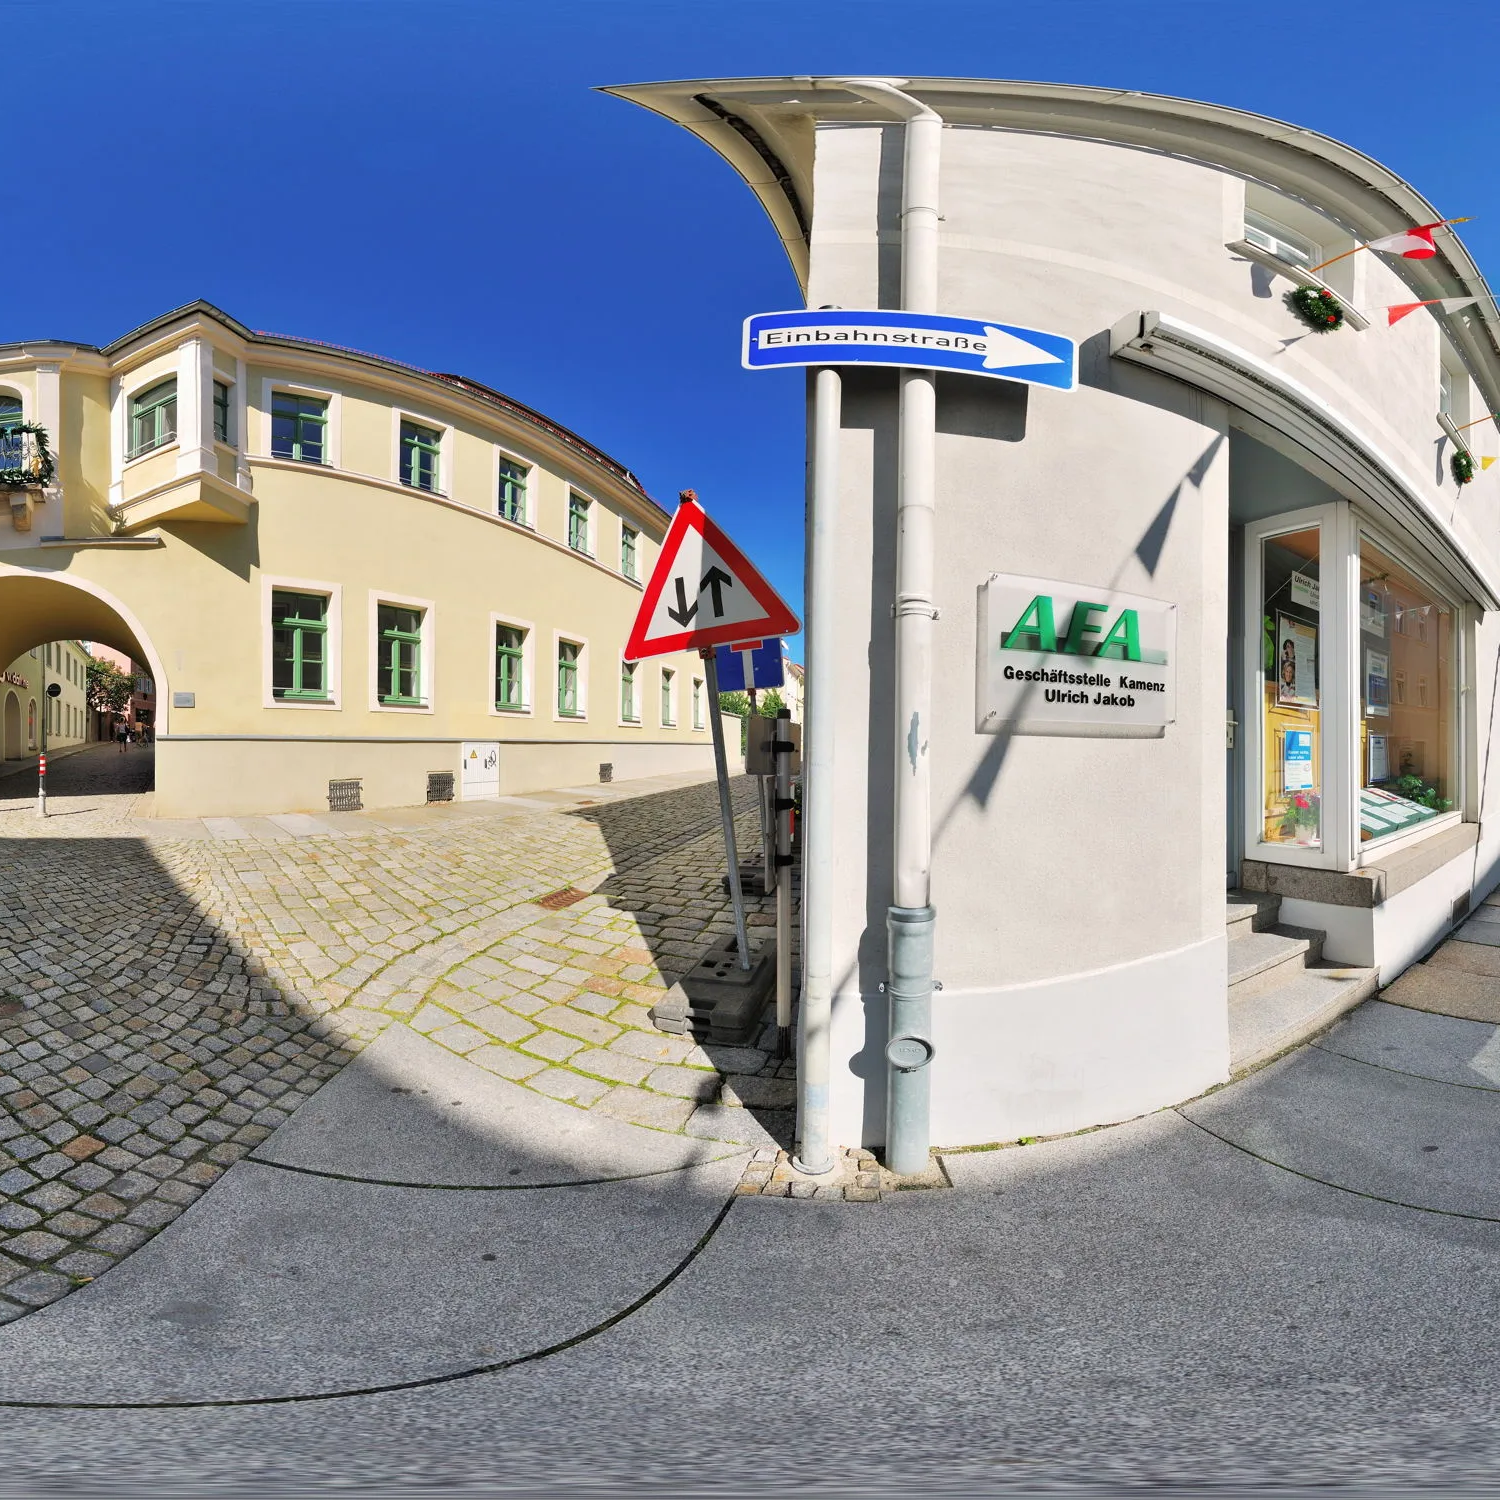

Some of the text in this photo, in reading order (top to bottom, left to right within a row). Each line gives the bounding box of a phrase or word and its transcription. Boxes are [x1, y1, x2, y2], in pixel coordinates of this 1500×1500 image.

[766, 329, 987, 352] Einbahnstraße
[1003, 594, 1142, 662] AFA
[1003, 665, 1165, 692] Geschäftsstelle Kamenz
[1044, 688, 1136, 707] Ulrich Jakob
